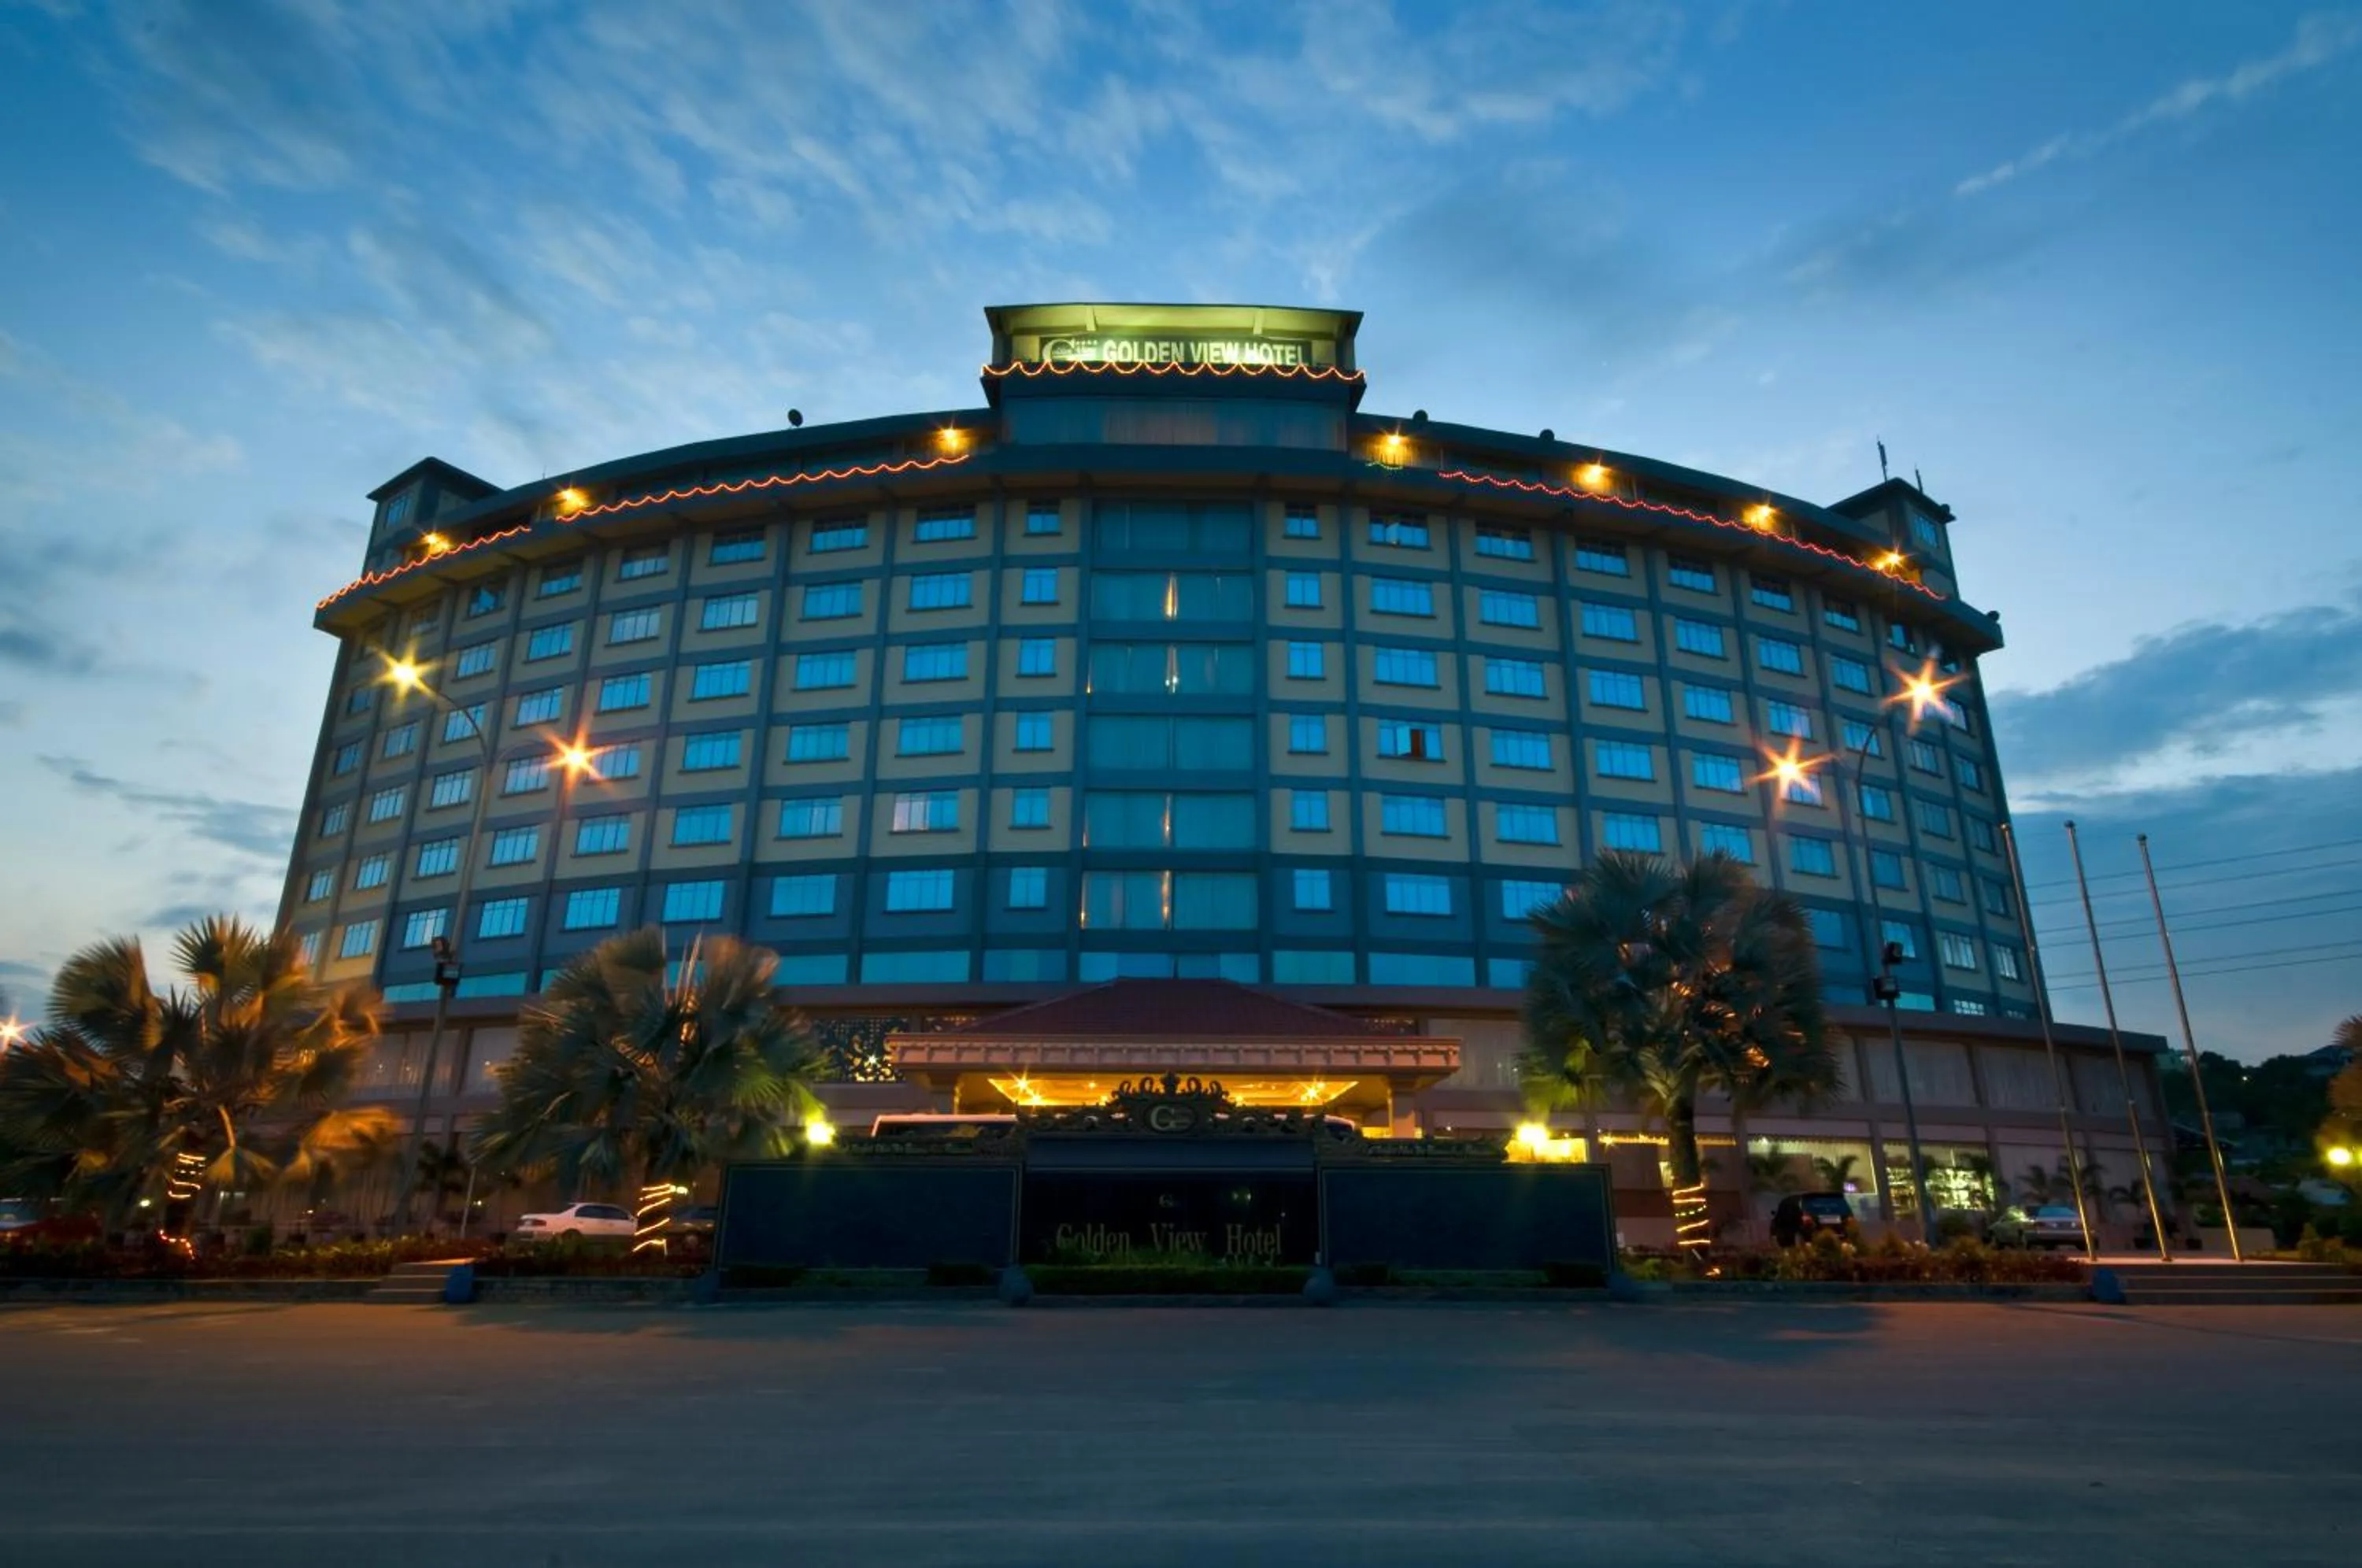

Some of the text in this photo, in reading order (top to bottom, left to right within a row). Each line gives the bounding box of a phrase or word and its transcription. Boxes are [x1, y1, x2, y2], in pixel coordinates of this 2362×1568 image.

[1103, 339, 1308, 366] GOLDEN VIEW HOTEL
[1056, 1222, 1283, 1256] Golden View Hotel
